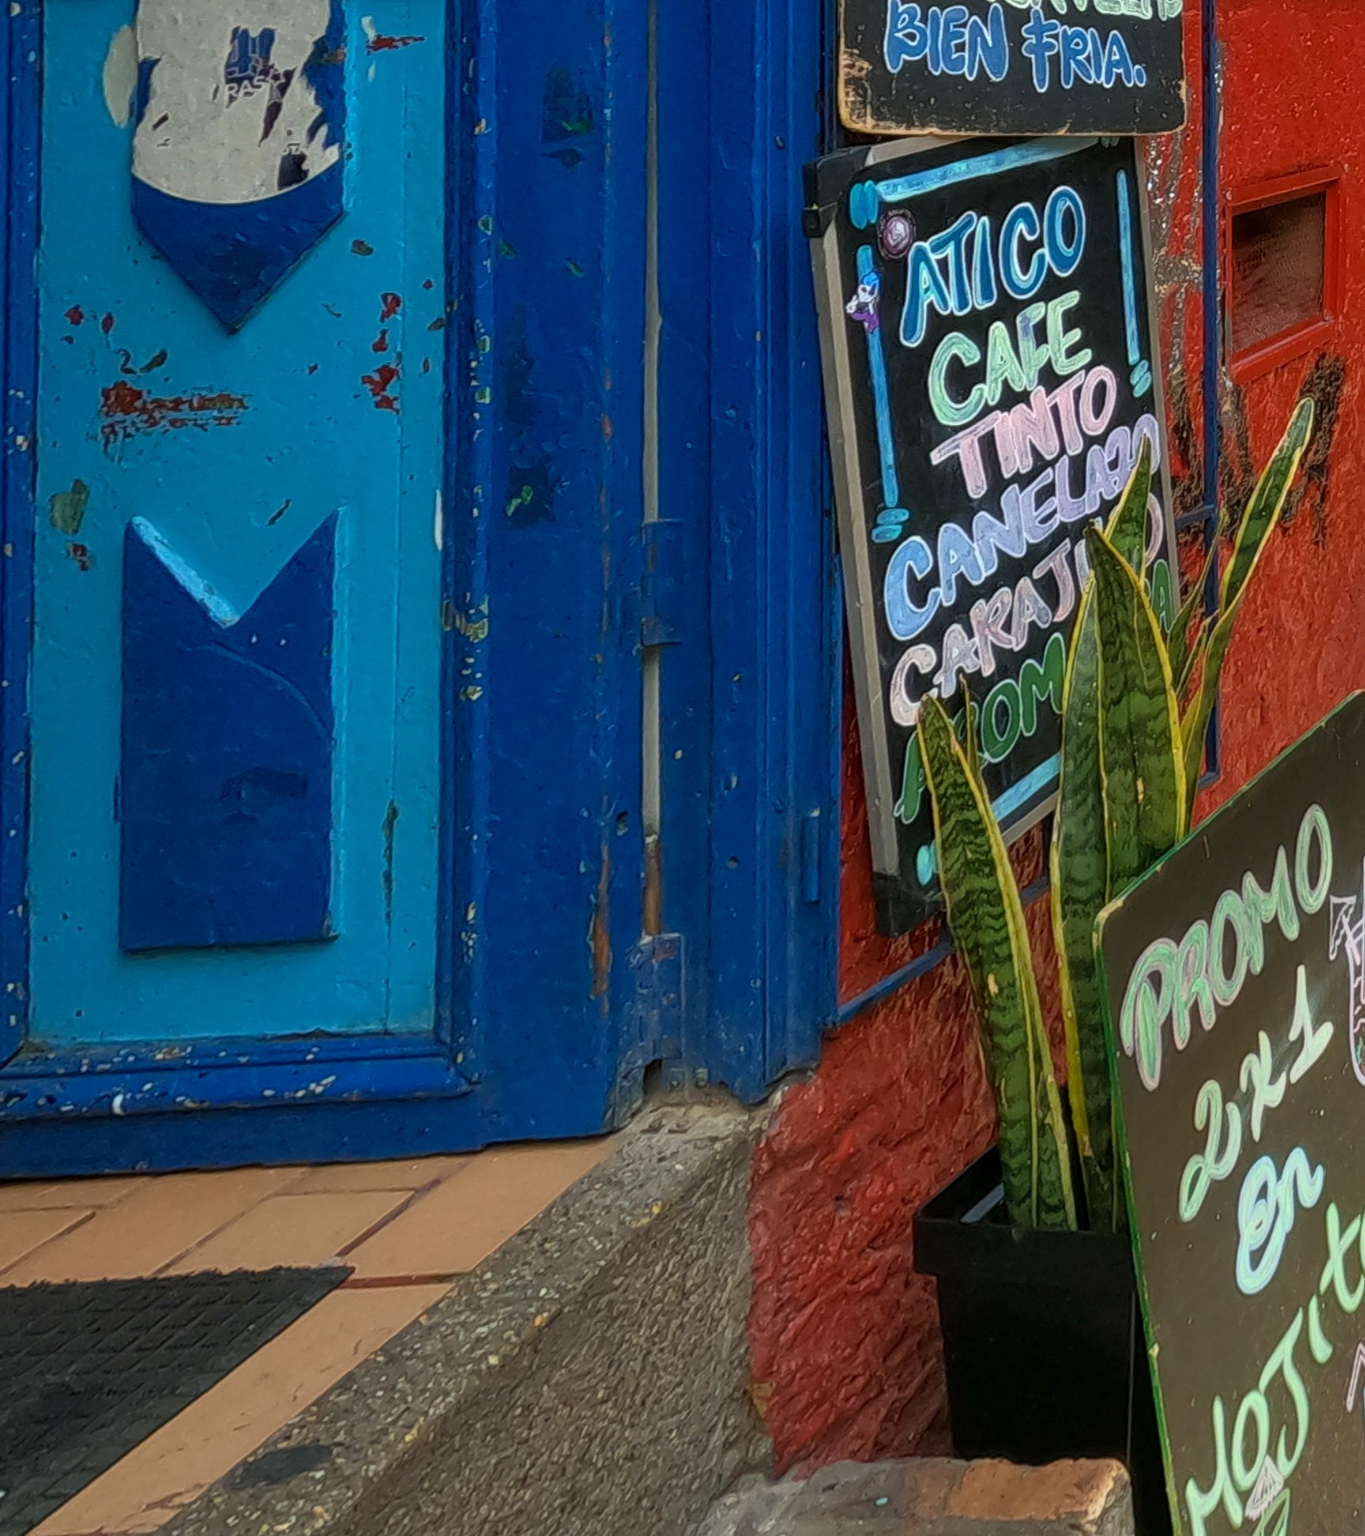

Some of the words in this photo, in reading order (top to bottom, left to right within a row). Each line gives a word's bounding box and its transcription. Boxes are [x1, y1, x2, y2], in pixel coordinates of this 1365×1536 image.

[899, 185, 1086, 347] ATICO
[926, 289, 1092, 427] CAFE
[930, 365, 1118, 499] TINTO
[1120, 803, 1333, 1093] PROMO
